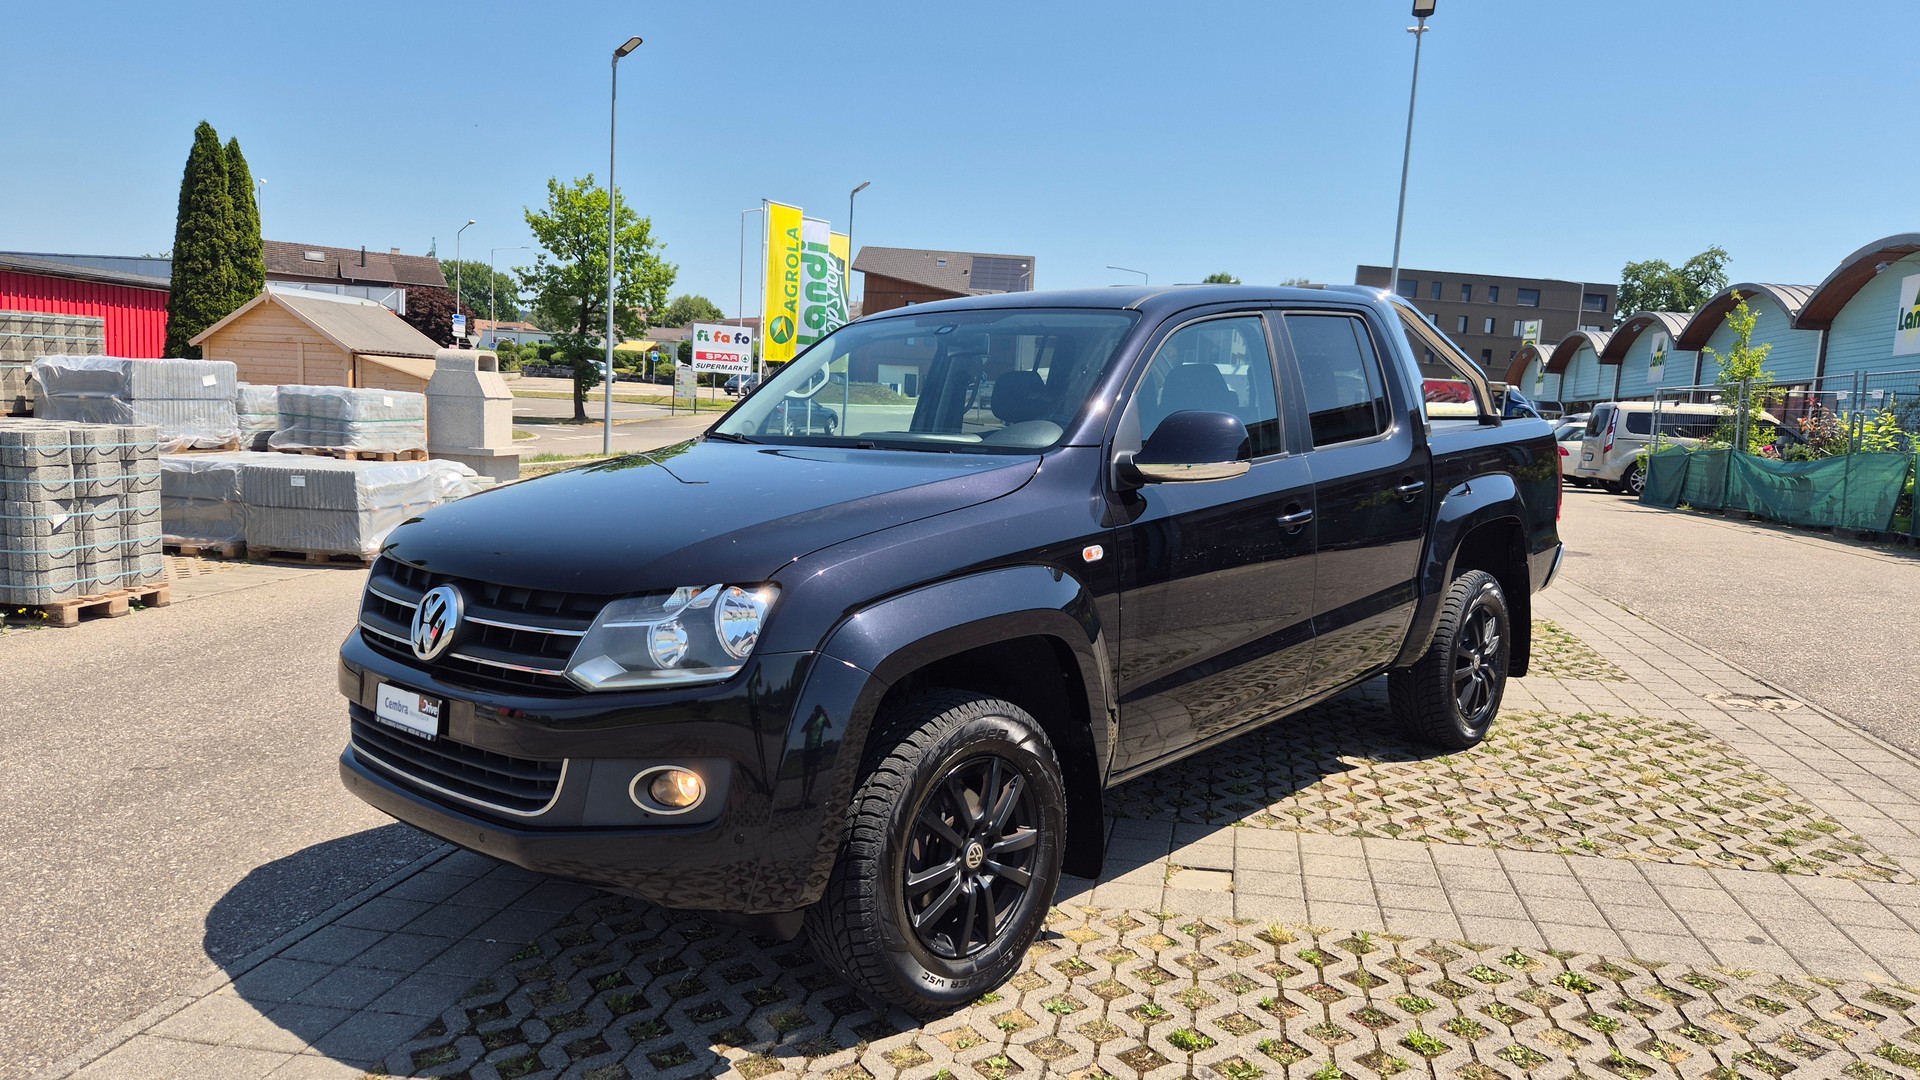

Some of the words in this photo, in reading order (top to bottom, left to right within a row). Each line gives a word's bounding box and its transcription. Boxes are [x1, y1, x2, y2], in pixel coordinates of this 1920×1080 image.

[784, 228, 800, 314] AGROLA
[796, 240, 830, 345] Landi
[1897, 307, 1920, 331] Lan
[697, 330, 710, 342] fi
[714, 331, 731, 343] fa
[734, 333, 750, 345] fo
[705, 353, 738, 362] SPAR
[695, 362, 749, 372] SUPERMARKT
[384, 696, 409, 715] Cembra
[922, 971, 945, 987] WSC
